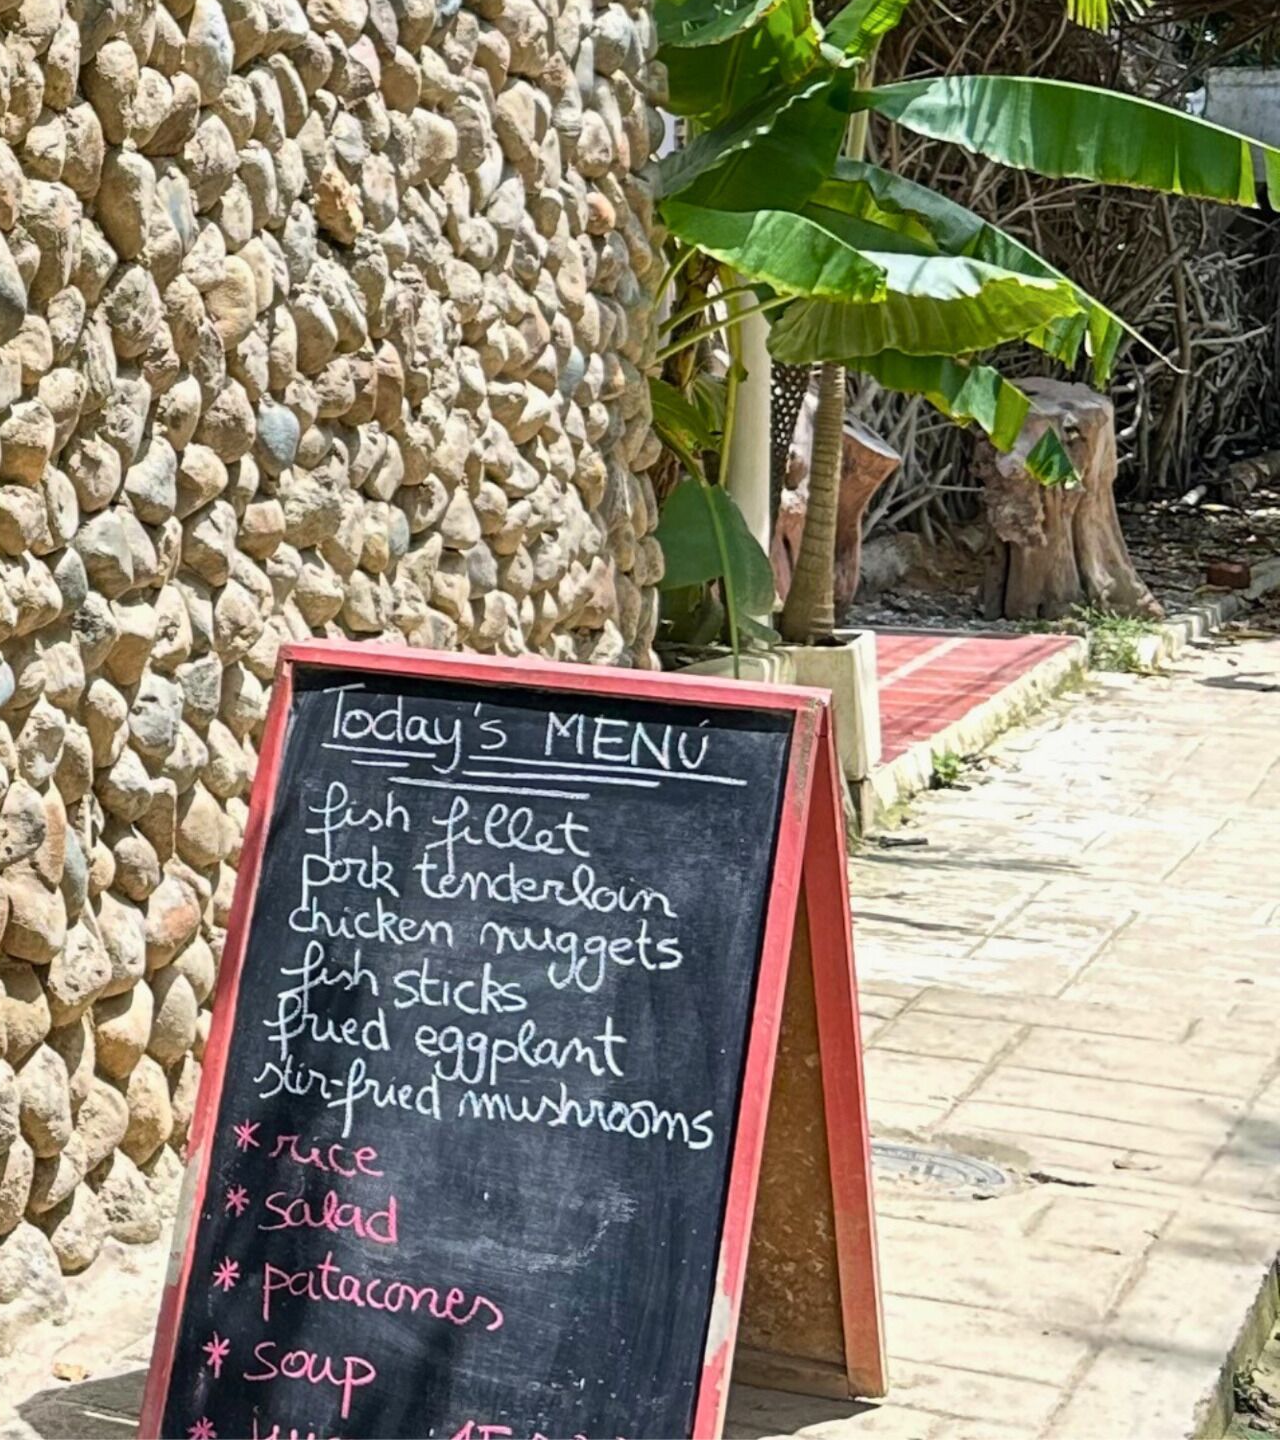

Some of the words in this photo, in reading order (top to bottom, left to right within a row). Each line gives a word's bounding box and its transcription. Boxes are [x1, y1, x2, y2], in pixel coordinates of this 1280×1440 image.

[322, 683, 508, 773] Today's
[305, 781, 410, 861] fish
[425, 795, 591, 876] fillet
[302, 846, 400, 910] pork
[414, 852, 679, 919] tenderloin
[277, 940, 380, 1015] fish
[393, 958, 529, 1015] sticks
[288, 897, 454, 948] chicken
[480, 919, 684, 993] nuggets
[263, 993, 391, 1061] fried
[414, 1016, 628, 1086] eggplant
[253, 1053, 442, 1139] stir-fried
[457, 1083, 715, 1150] mushrooms
[268, 1134, 385, 1177] rice
[257, 1190, 399, 1245] salad
[261, 1250, 505, 1331] patacones
[243, 1341, 377, 1420] soup
